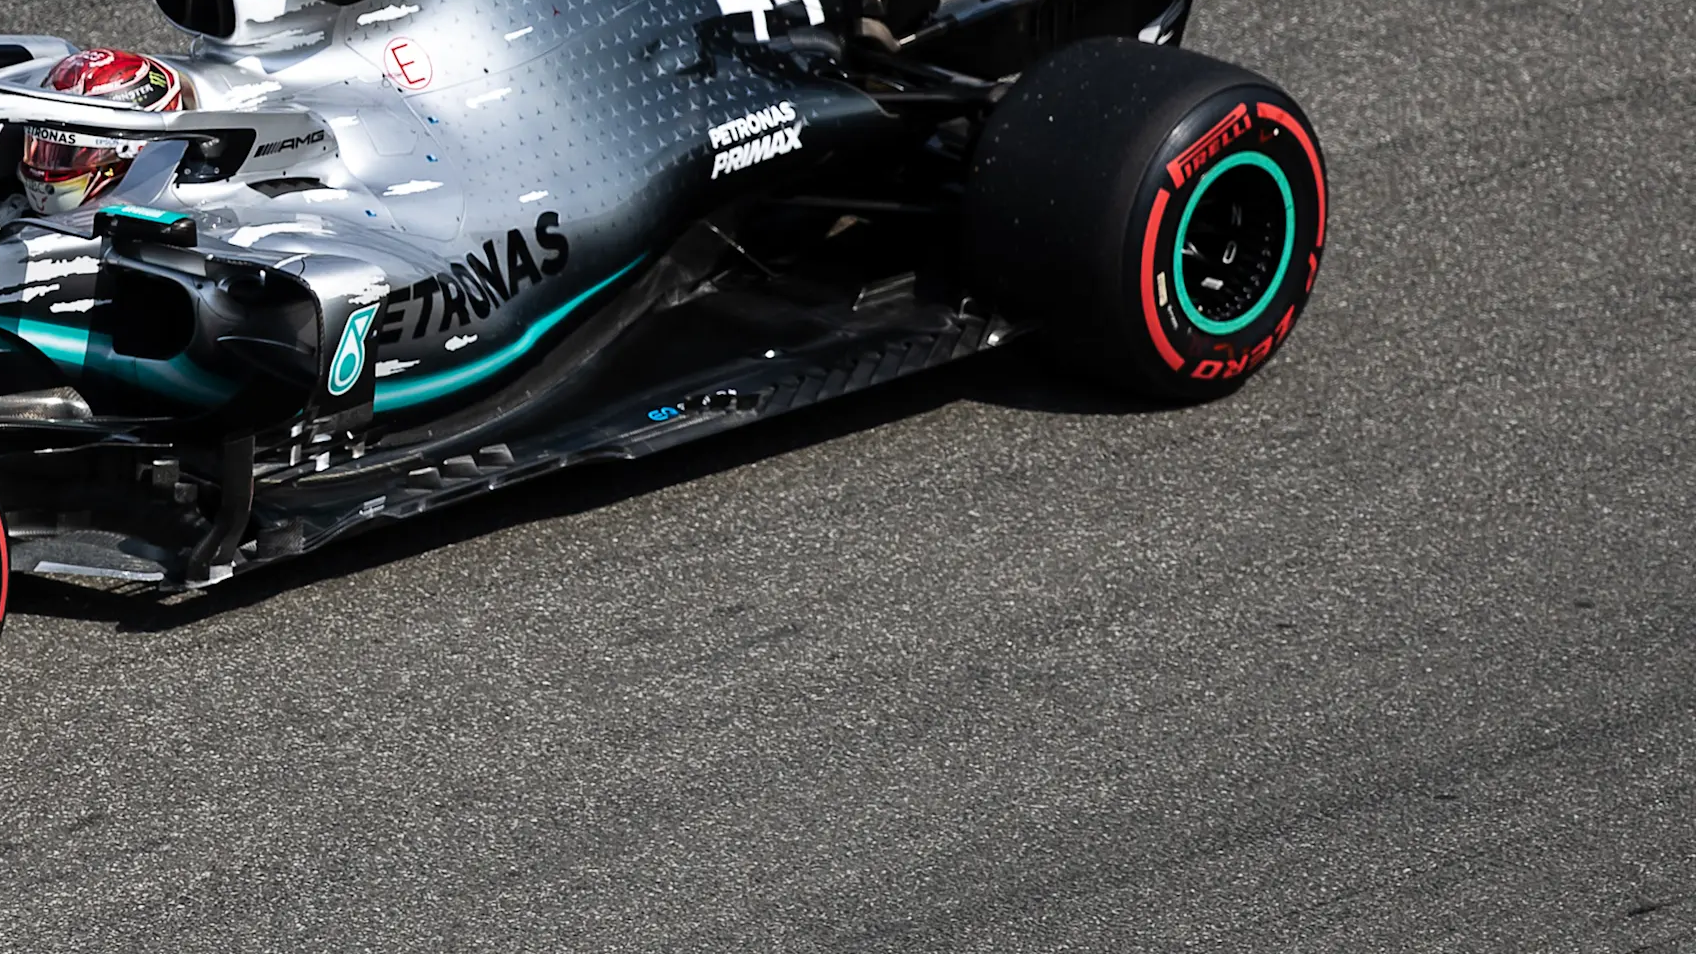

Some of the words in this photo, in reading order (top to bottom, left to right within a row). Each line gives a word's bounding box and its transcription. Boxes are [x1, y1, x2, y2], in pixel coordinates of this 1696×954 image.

[278, 129, 325, 153] AMG
[708, 100, 797, 150] PETRONAS
[710, 119, 805, 180] PRIMAX
[1166, 102, 1253, 189] PIRELLI
[380, 210, 570, 344] ETRONAS
